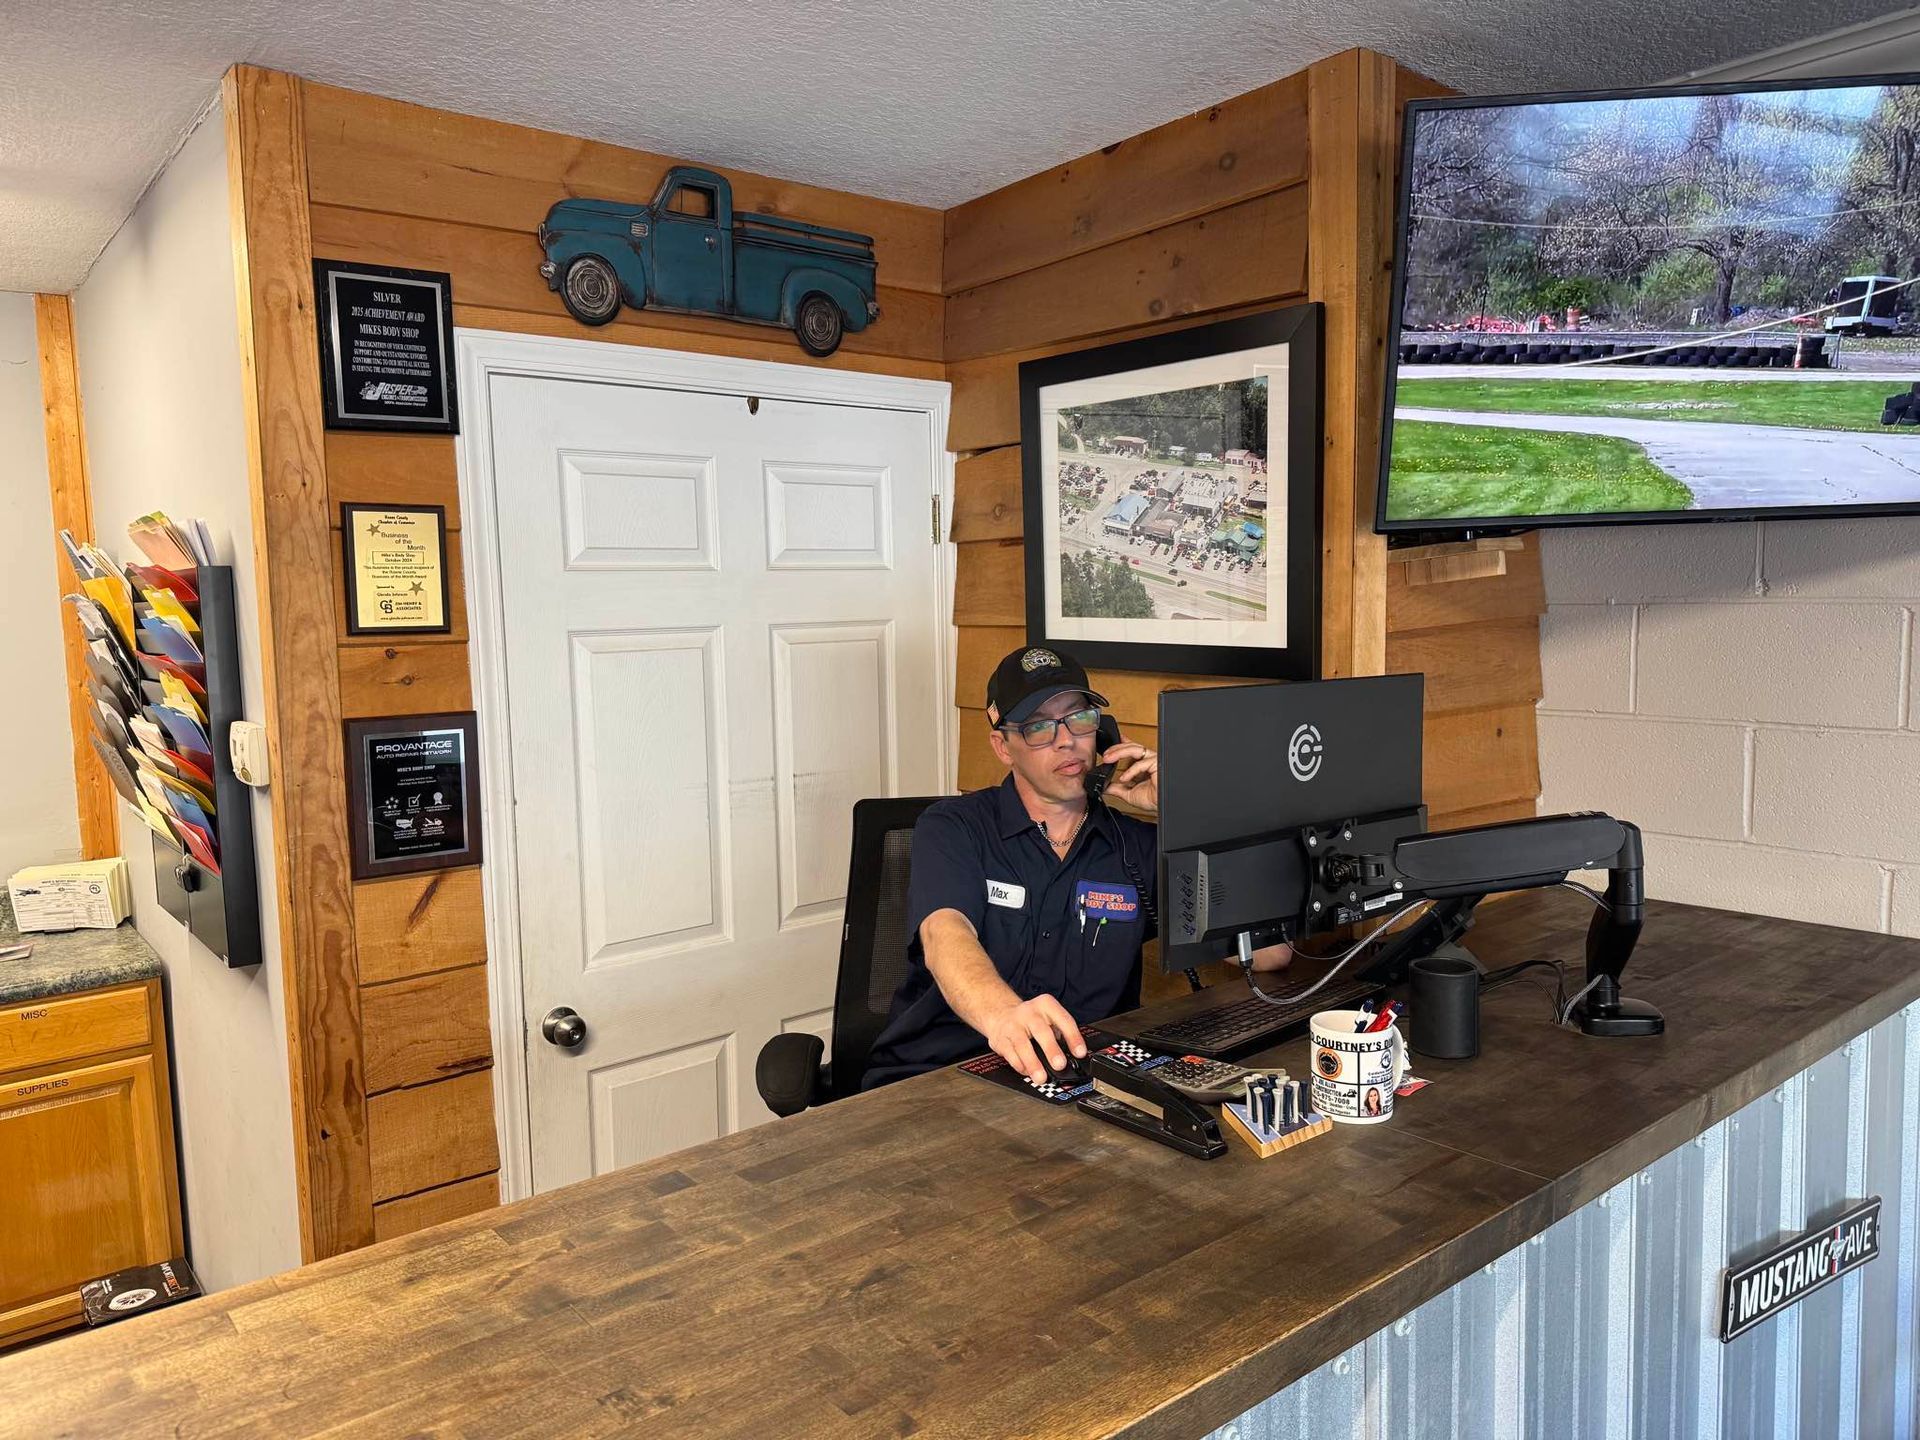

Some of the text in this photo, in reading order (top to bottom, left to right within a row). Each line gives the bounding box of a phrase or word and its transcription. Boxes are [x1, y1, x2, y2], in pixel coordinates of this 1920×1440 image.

[374, 292, 401, 304] SILVER
[364, 308, 406, 320] ACHIEVEMENT
[406, 312, 426, 322] AWARD
[360, 324, 420, 338] MIKES BODY SHOP
[366, 382, 412, 400] JASPER
[376, 740, 453, 752] PROVANTAGE
[990, 886, 1008, 900] Max
[1088, 891, 1123, 902] MIKE'S
[1085, 899, 1136, 911] ODY SHOP
[21, 1009, 47, 1020] MISC
[1316, 1035, 1381, 1051] COURTNEY'S
[17, 1079, 69, 1096] SUPPLIES
[1739, 1216, 1873, 1322] MUSTANG AVE
